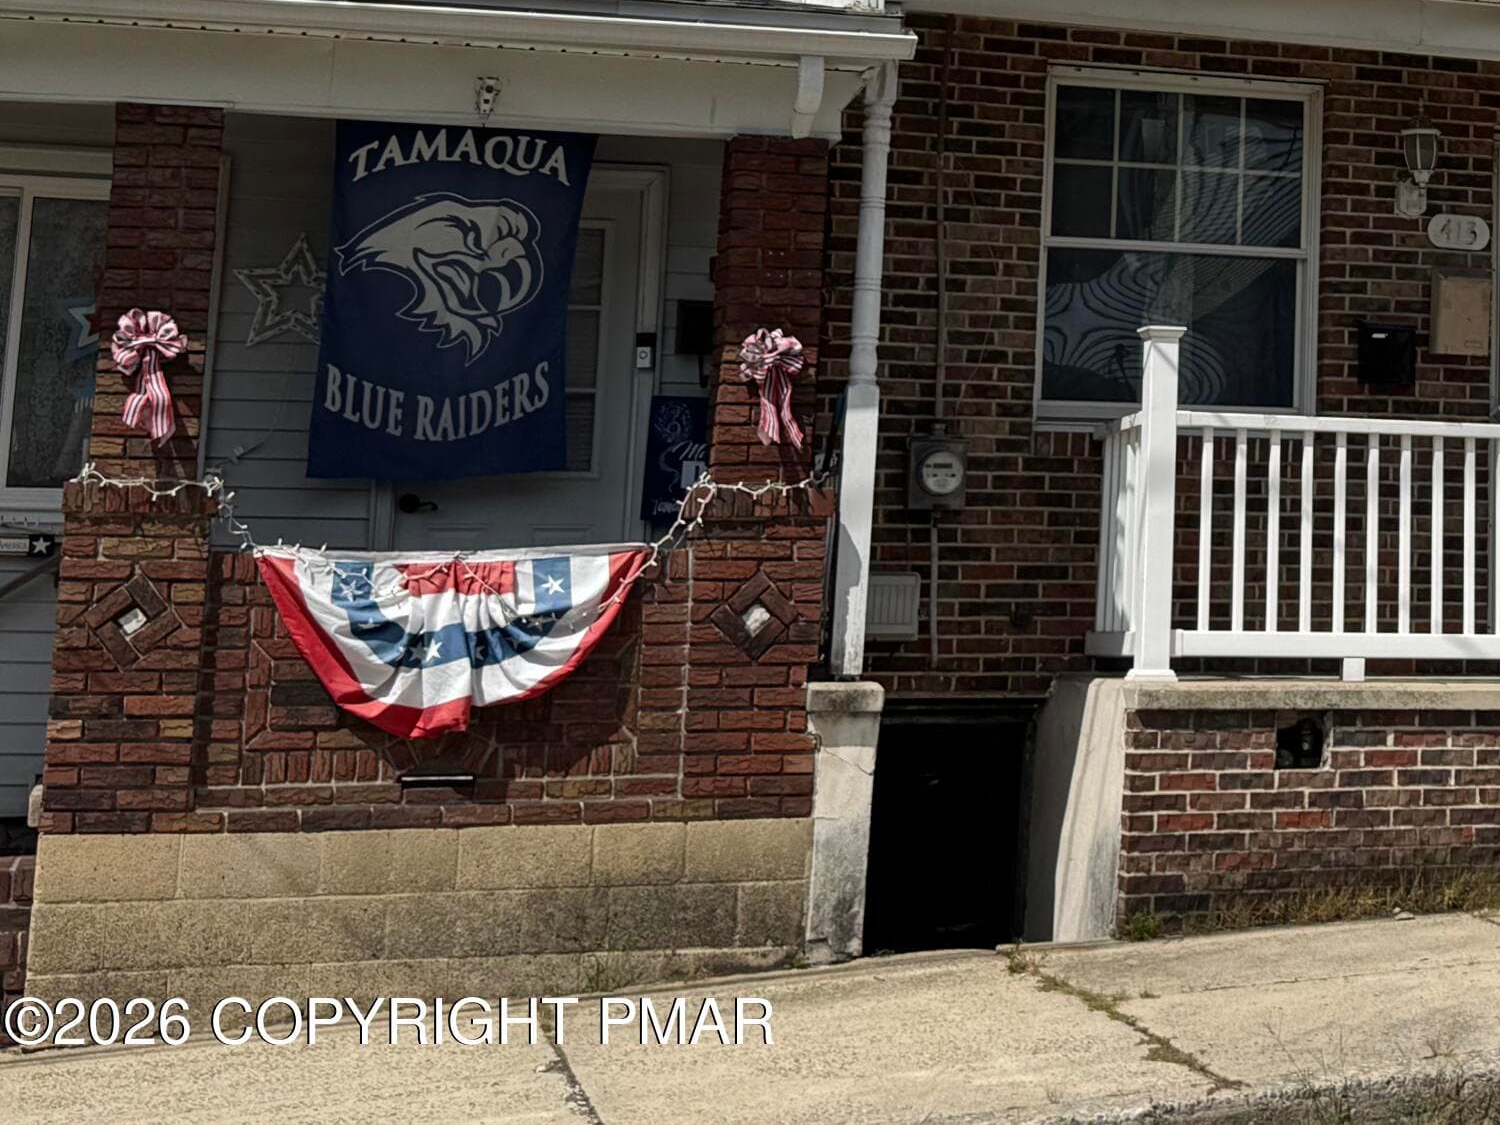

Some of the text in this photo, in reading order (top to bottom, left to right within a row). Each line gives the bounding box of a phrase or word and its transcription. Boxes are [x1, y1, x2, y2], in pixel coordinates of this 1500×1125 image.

[349, 128, 570, 186] TAMAQUA
[1440, 218, 1478, 246] 413
[324, 360, 550, 442] BLUE RAIDERS
